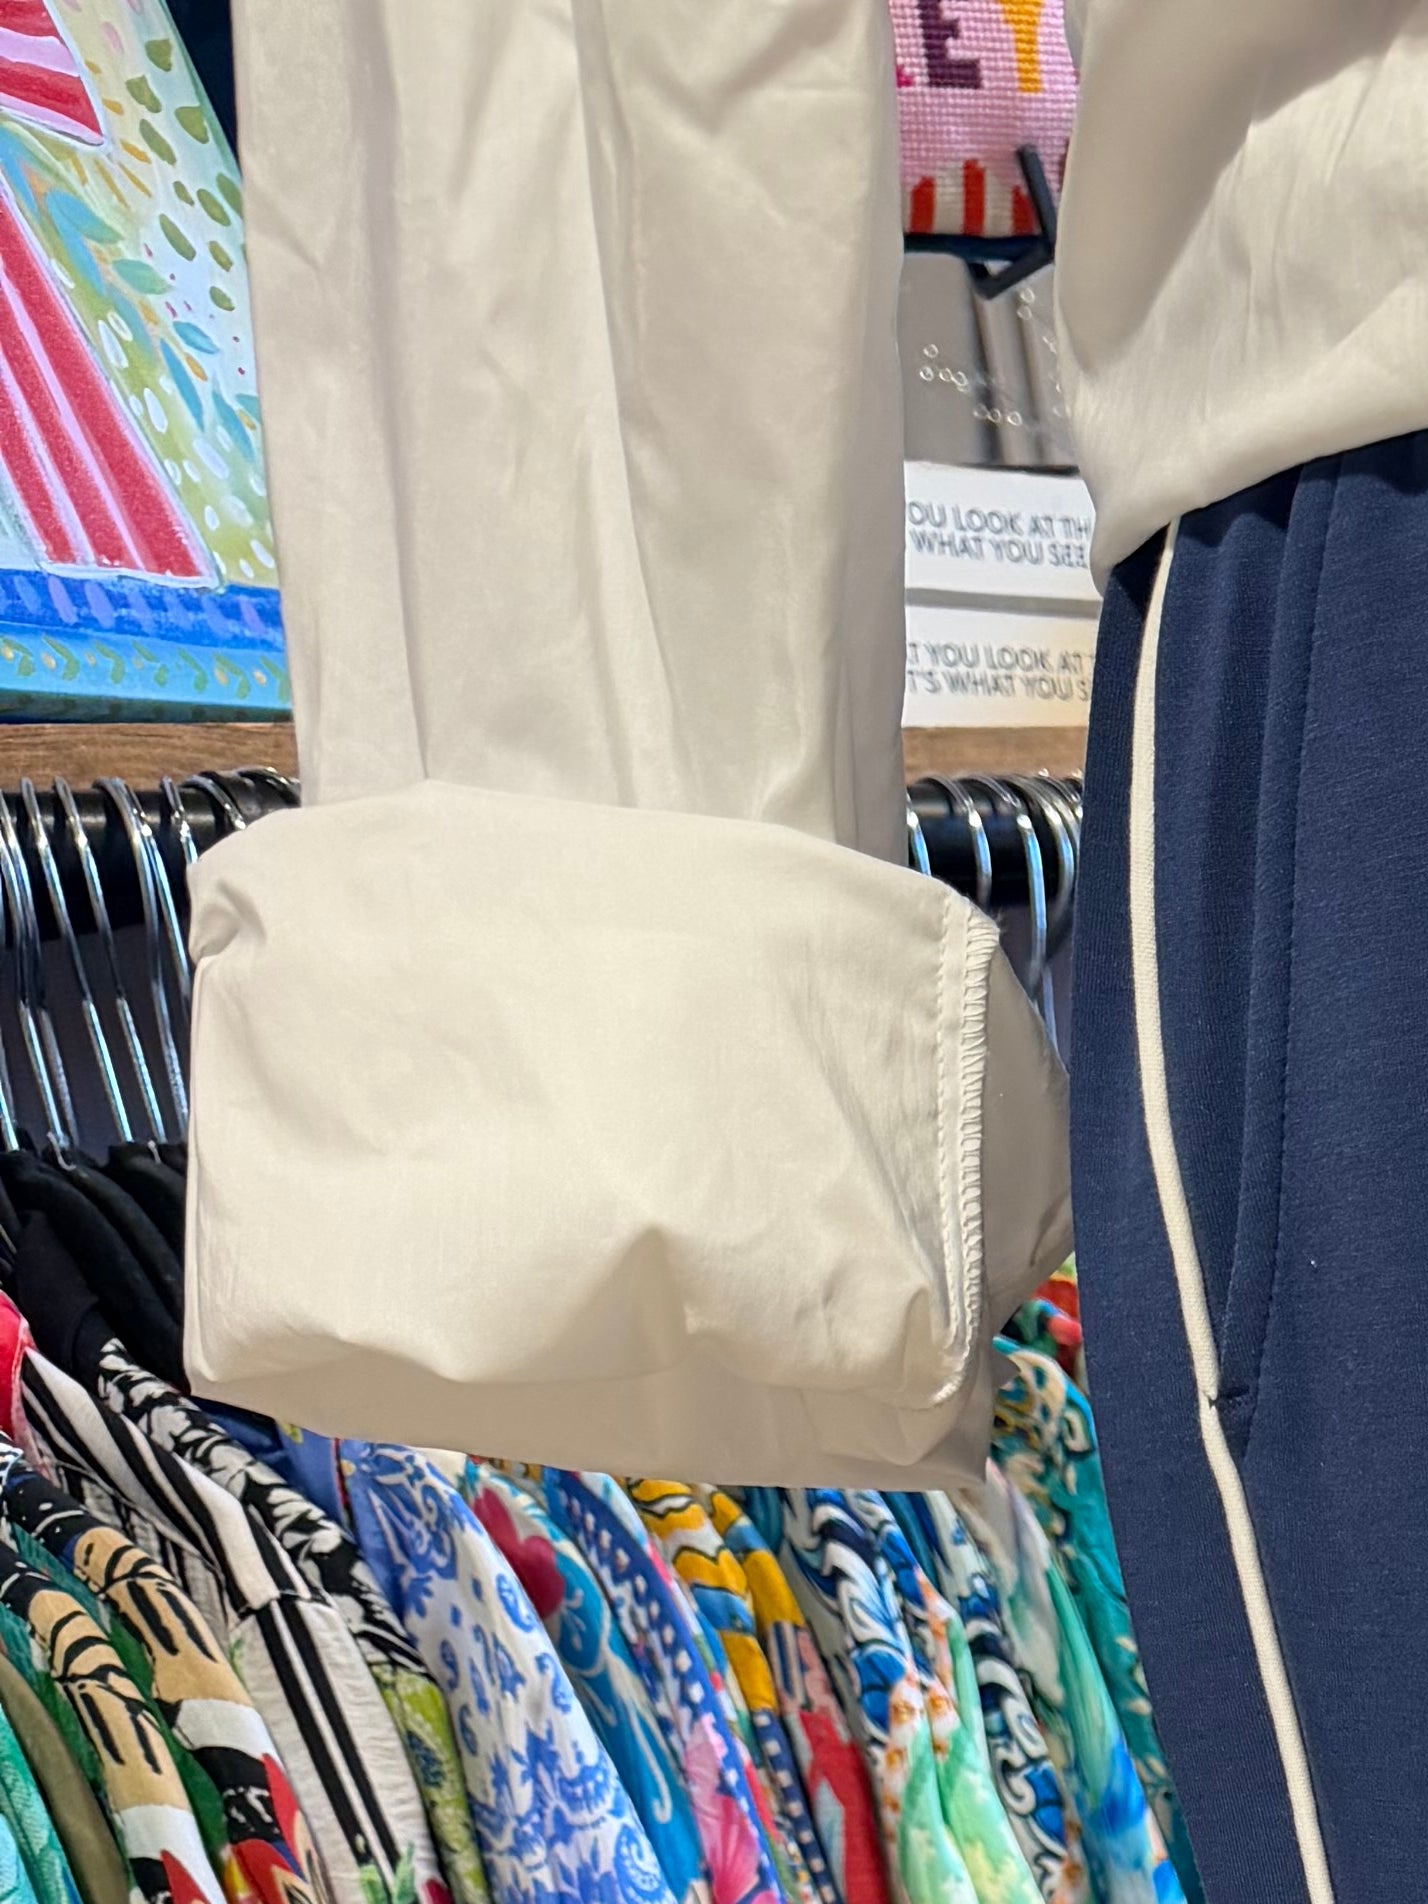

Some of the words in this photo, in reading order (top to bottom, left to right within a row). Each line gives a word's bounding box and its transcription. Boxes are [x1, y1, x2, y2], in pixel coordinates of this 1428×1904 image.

[908, 502, 946, 527] OU
[952, 505, 1023, 536] LOOK
[1029, 514, 1055, 539] AT
[1059, 516, 1090, 540] TH
[909, 528, 985, 559] WHAT
[989, 537, 1044, 565] YOU
[923, 641, 980, 669] YOU
[984, 643, 1053, 672] LOOK
[1059, 650, 1085, 675] AT
[906, 669, 941, 694] T'S
[943, 671, 1016, 697] WHAT
[1020, 675, 1074, 702] YOU
[1077, 679, 1090, 703] S
